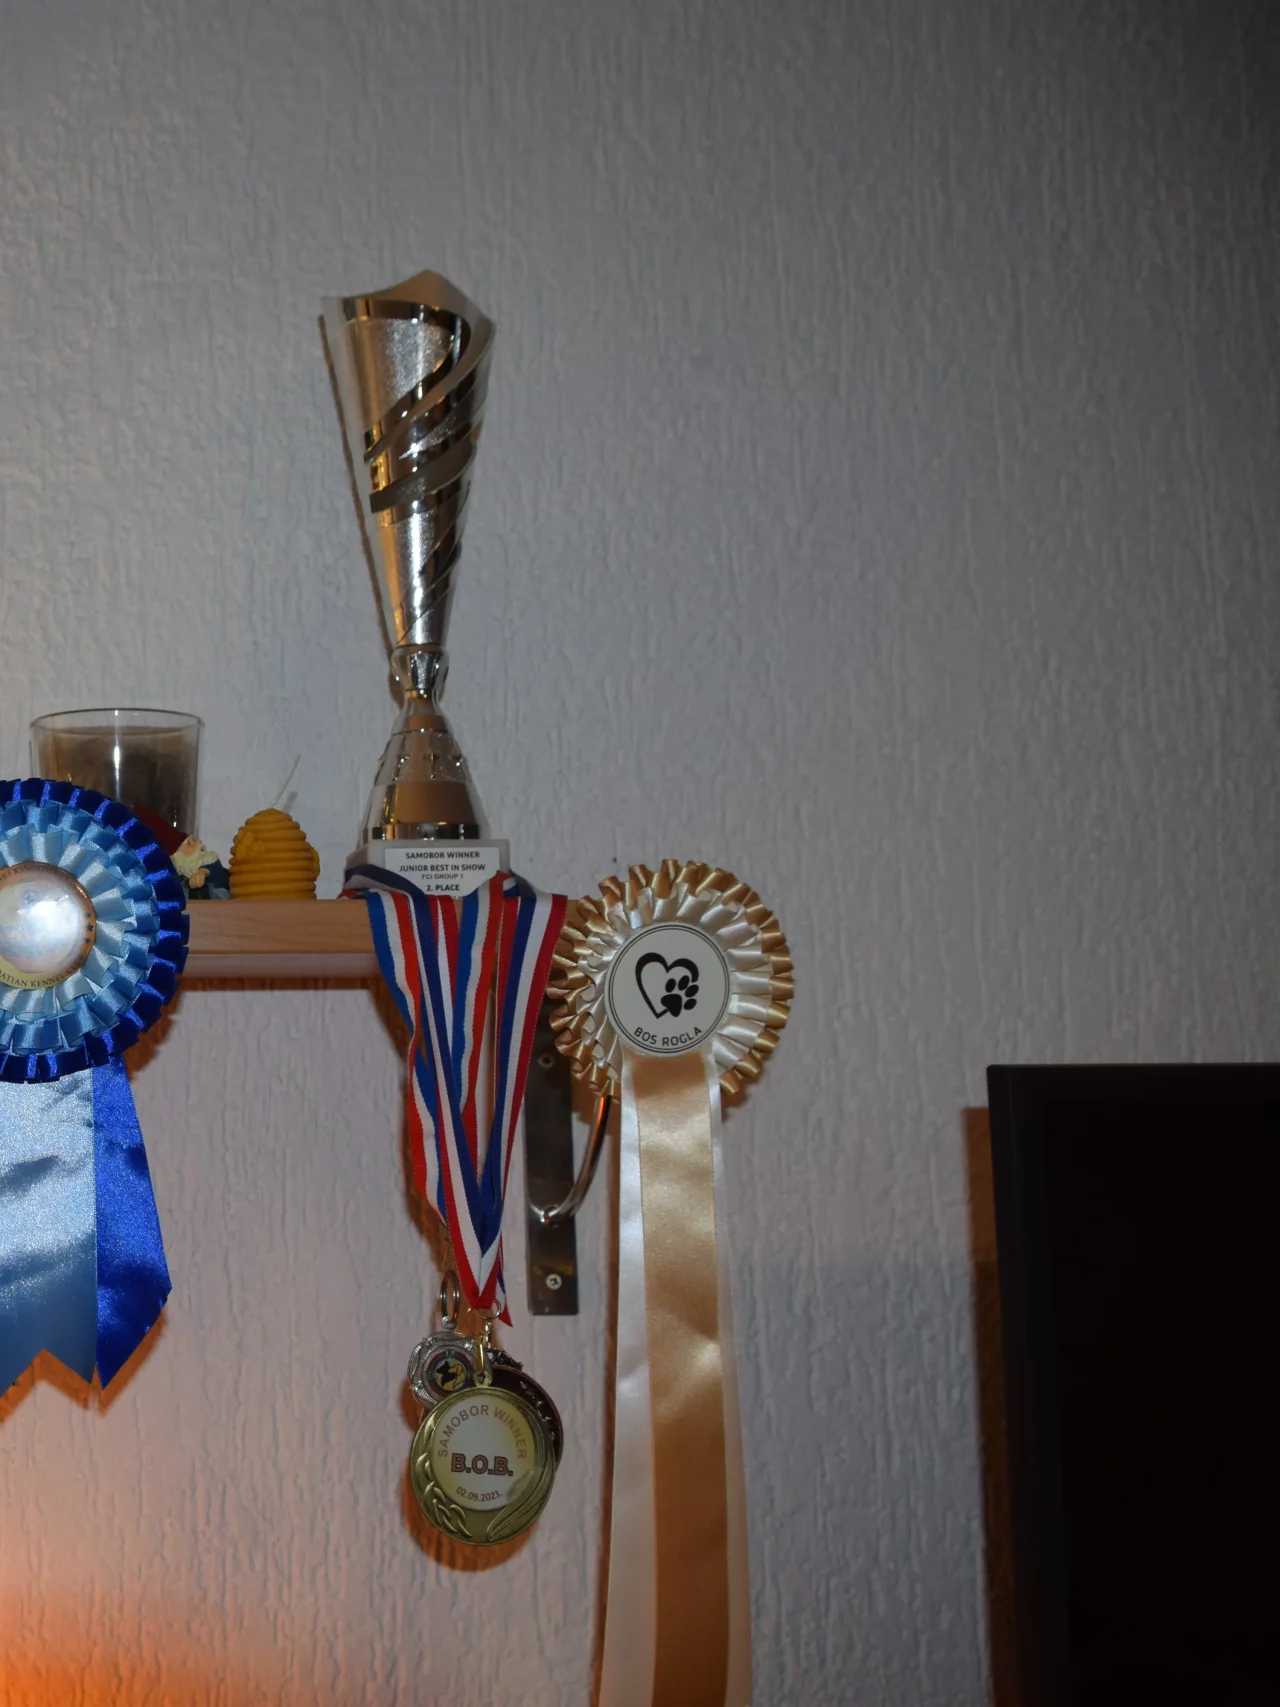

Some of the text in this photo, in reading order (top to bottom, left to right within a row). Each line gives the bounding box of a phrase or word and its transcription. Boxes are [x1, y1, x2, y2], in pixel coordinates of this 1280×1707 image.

[405, 851, 480, 860] SAMOBOR WINNER
[399, 864, 429, 872] JUNIOR
[430, 864, 450, 872] BEST
[461, 863, 486, 871] SHOW
[426, 884, 460, 892] 2. PLACE
[31, 975, 64, 987] KENNEL
[633, 1026, 703, 1047] BOS ROGLA
[437, 1404, 527, 1459] SAMOBOR WINNER
[451, 1452, 514, 1476] B.O.B.
[456, 1486, 503, 1503] 02.09.2023.
